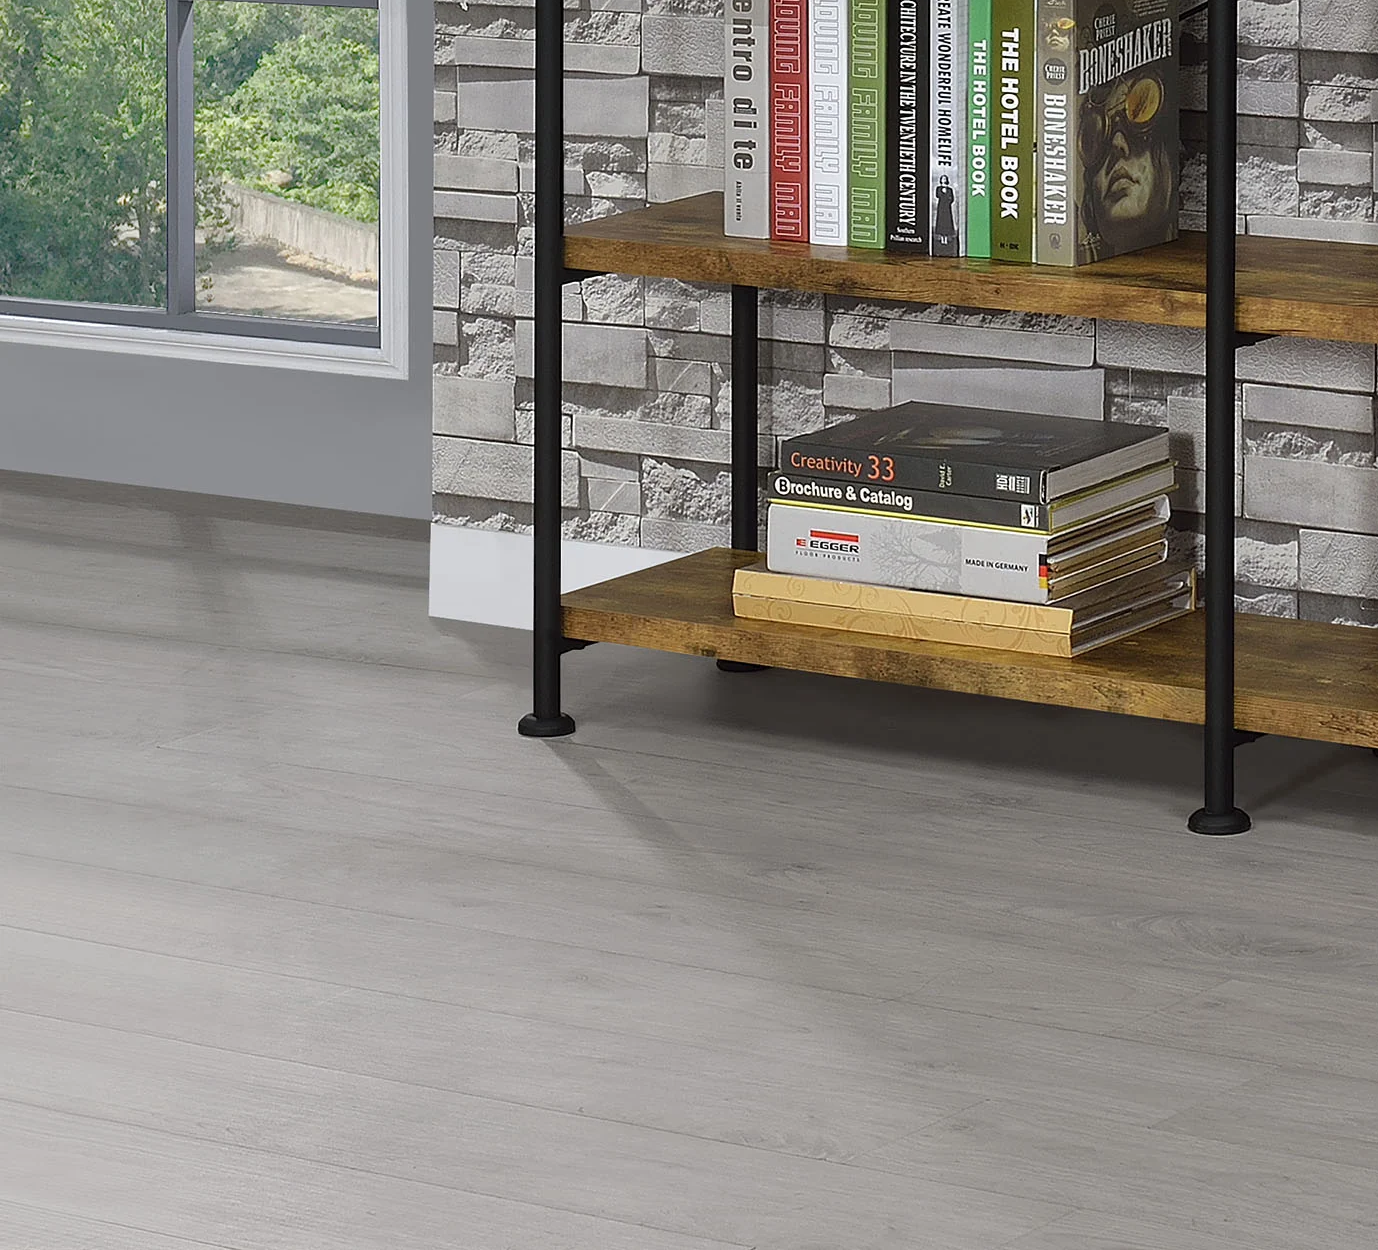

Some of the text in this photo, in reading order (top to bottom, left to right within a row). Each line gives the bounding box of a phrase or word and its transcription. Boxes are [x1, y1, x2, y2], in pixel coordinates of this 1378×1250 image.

[900, 71, 917, 83] IN
[937, 33, 952, 105] WONDERFUL
[1000, 28, 1020, 72] THE
[1079, 18, 1172, 94] BONESHAKER
[732, 97, 757, 129] di
[899, 85, 917, 107] THE
[971, 40, 986, 197] THE HOTEL BOOK
[1000, 78, 1020, 150] HOTEL
[732, 140, 757, 171] te
[774, 83, 801, 173] FAMILY
[813, 85, 840, 174] FAMILY
[851, 88, 877, 178] FAMILY
[899, 108, 917, 173] TWENTIETH
[937, 109, 952, 167] HOMELIFE
[1043, 93, 1067, 225] BONESHAKER
[775, 182, 801, 237] MAN
[814, 184, 840, 239] MAN
[850, 187, 877, 243] MAN
[899, 174, 916, 226] CENTURY
[1000, 155, 1020, 220] BOOK
[774, 476, 913, 511] Brochure & Catalog
[791, 452, 896, 482] Creativity 33
[810, 540, 860, 554] EGGER
[965, 558, 1028, 572] MADE IN GERMANY
